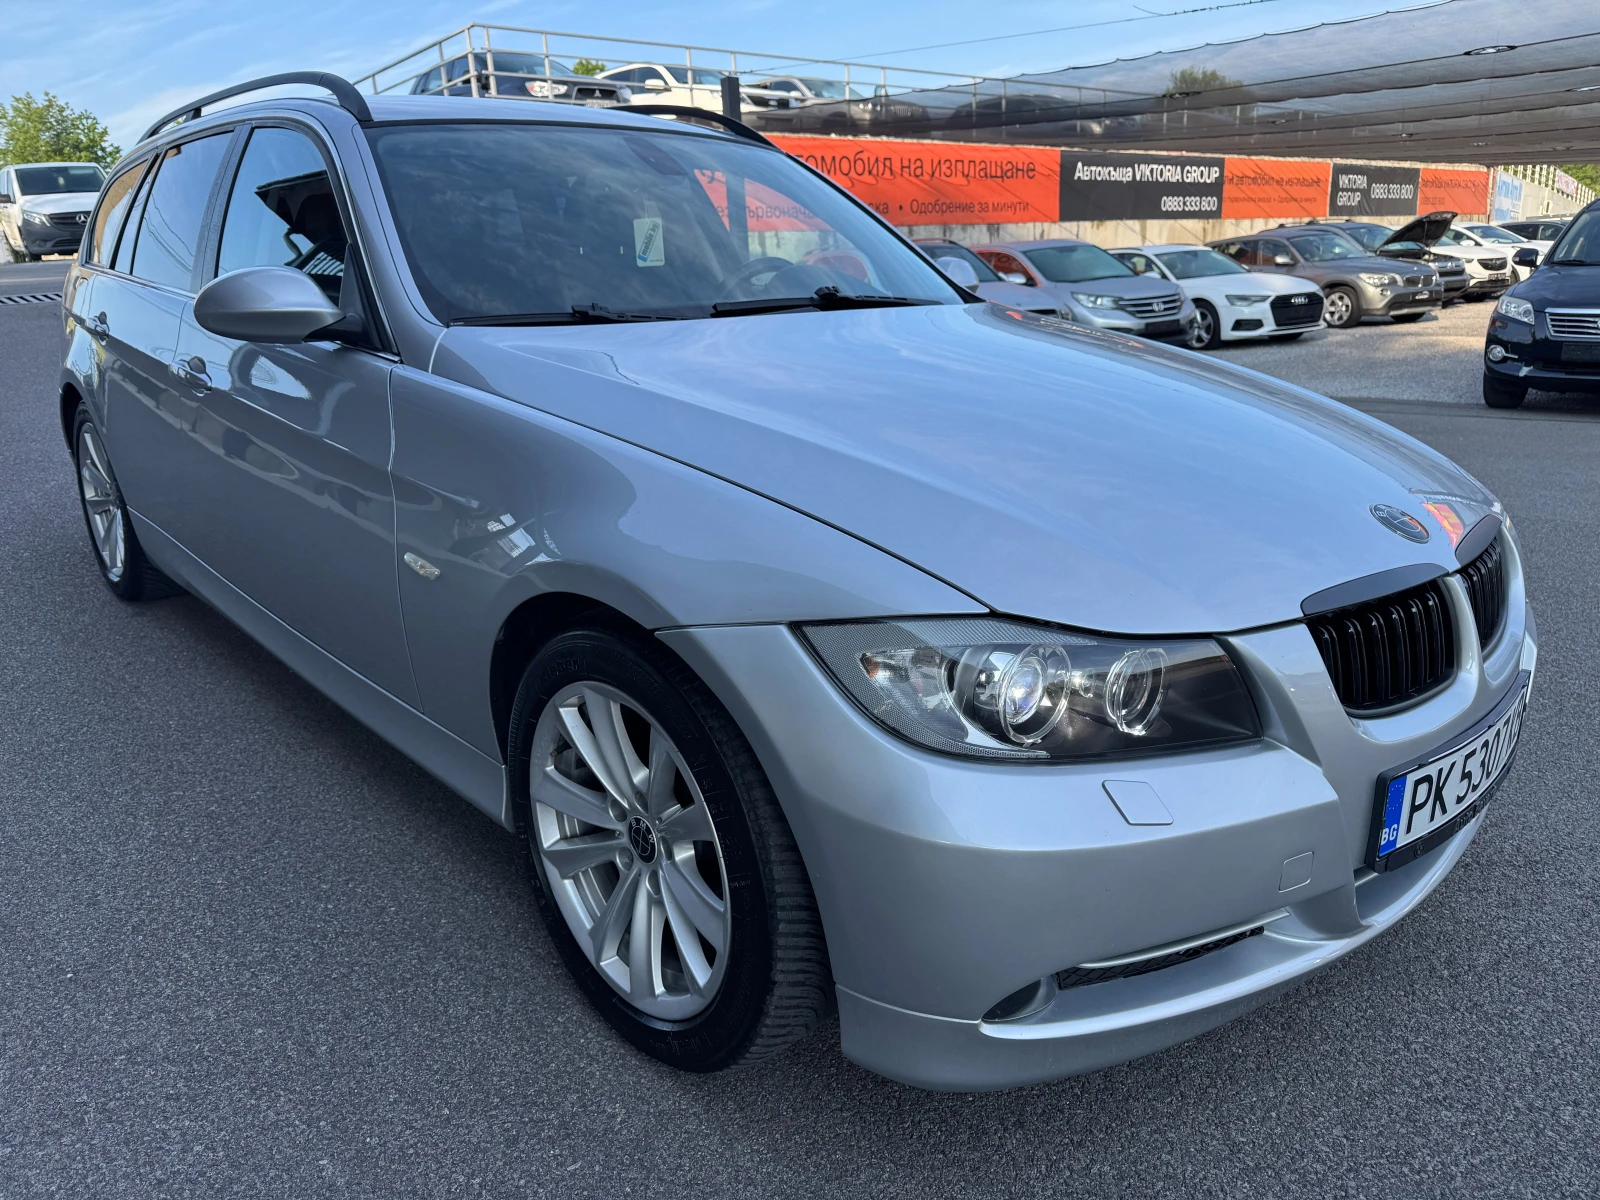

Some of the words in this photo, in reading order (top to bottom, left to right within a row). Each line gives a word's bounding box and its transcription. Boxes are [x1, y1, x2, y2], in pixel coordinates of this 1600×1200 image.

[795, 150, 893, 178] омобил
[900, 158, 924, 178] на
[931, 158, 1036, 183] изплащане
[1074, 161, 1133, 184] Автокъща
[1134, 164, 1182, 183] VIKTORIA
[1183, 166, 1220, 184] GROUP
[1338, 173, 1368, 190] VIKTORIA
[1337, 190, 1361, 206] GROUP
[1370, 183, 1388, 200] 0883
[1388, 184, 1400, 200] 333
[1401, 184, 1414, 200] 800
[910, 199, 975, 216] Одобрение
[977, 201, 990, 213] за
[992, 201, 1030, 216] минути
[1161, 195, 1183, 212] 0883
[1184, 196, 1200, 212] 333
[1200, 196, 1218, 212] 800
[1405, 759, 1457, 835] PK
[1456, 713, 1512, 805] 5307
[631, 819, 655, 843] BMW
[1381, 823, 1398, 845] BG
